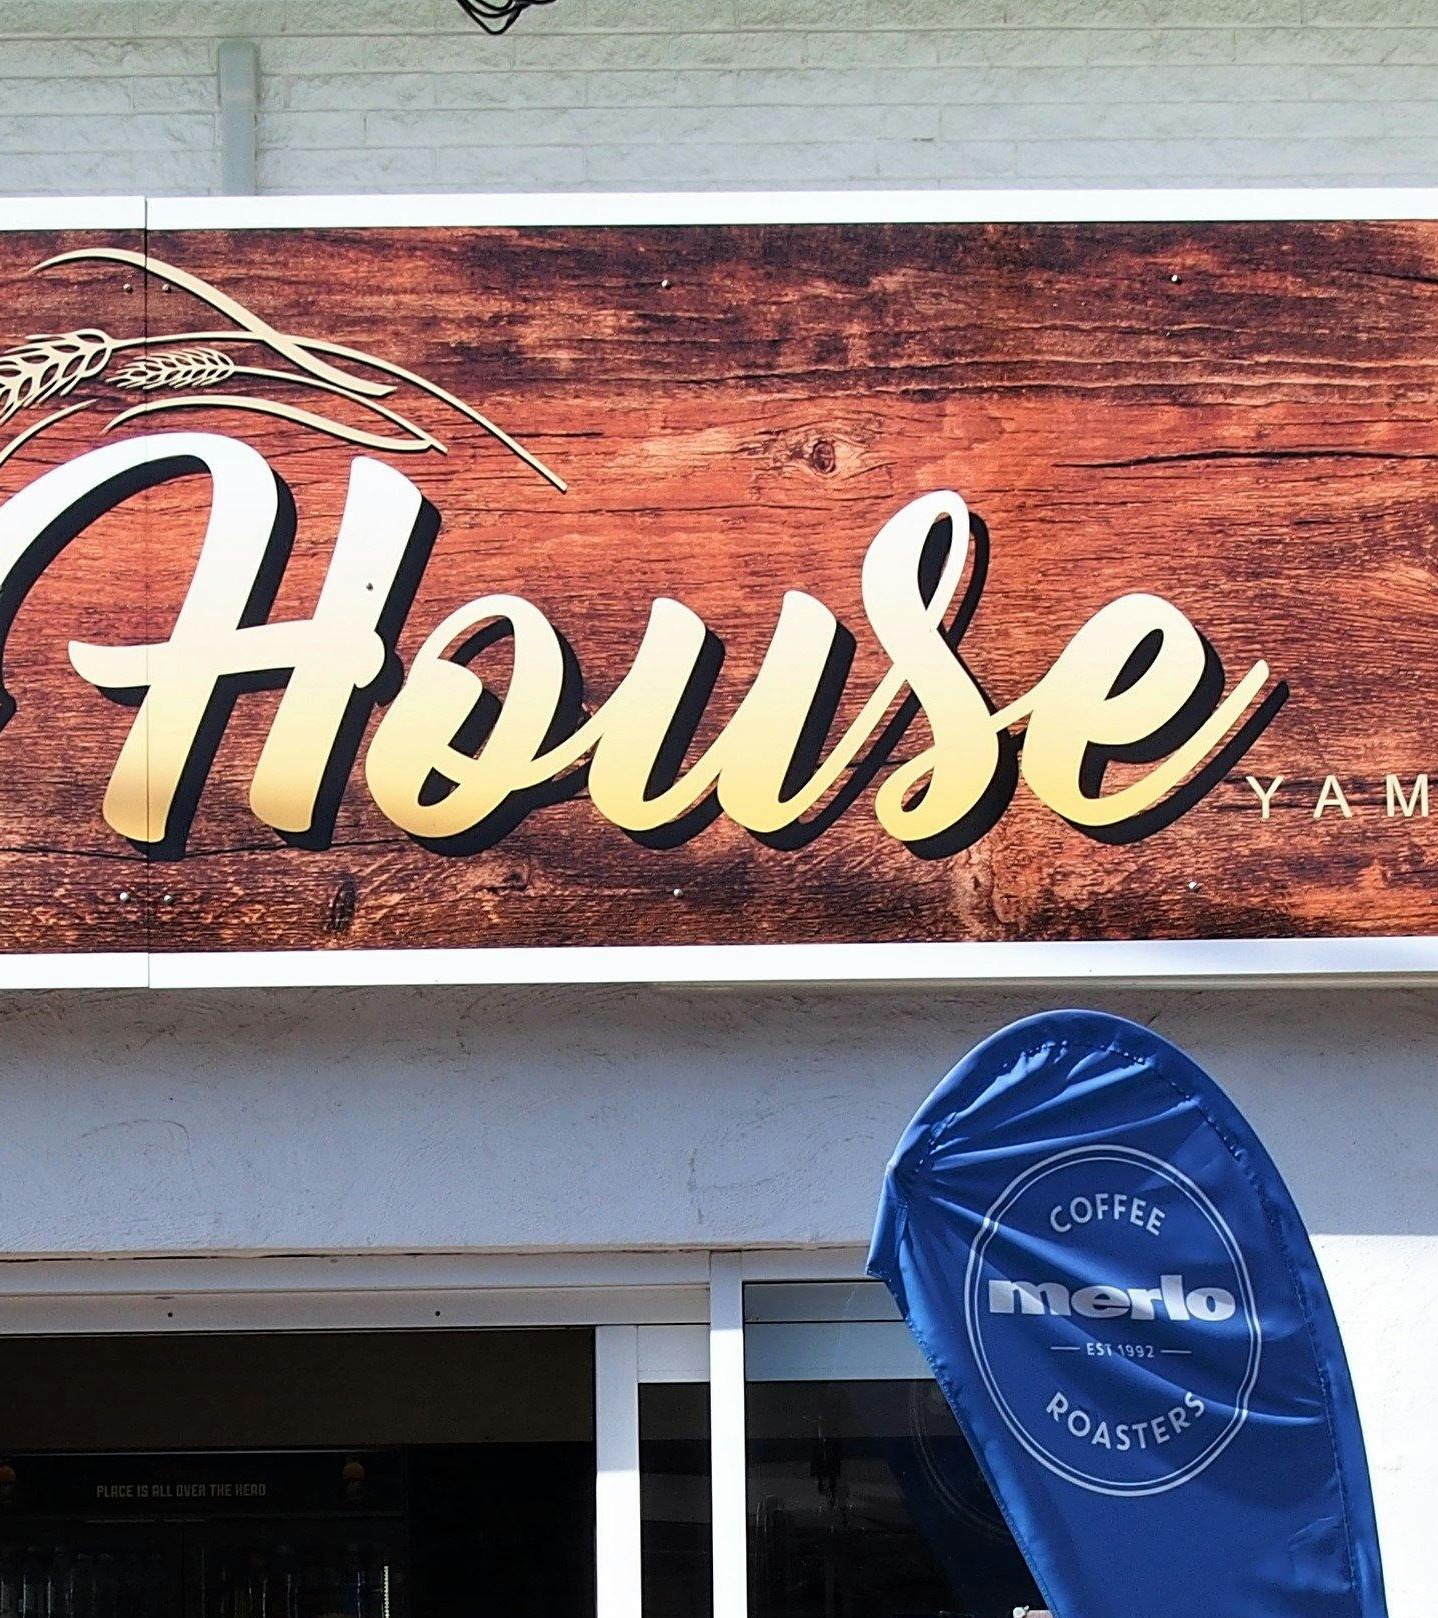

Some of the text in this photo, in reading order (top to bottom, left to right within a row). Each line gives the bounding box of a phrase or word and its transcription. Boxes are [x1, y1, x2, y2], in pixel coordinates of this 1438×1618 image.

[1050, 1193, 1166, 1237] COFFEE
[988, 1274, 1236, 1322] merlo
[1086, 1343, 1156, 1358] EST 1992
[1046, 1391, 1206, 1451] ROASTERS
[96, 1484, 134, 1498] PLACE
[137, 1484, 148, 1497] IS
[152, 1484, 173, 1497] ALL
[176, 1483, 206, 1497] OVER
[209, 1483, 232, 1497] THE
